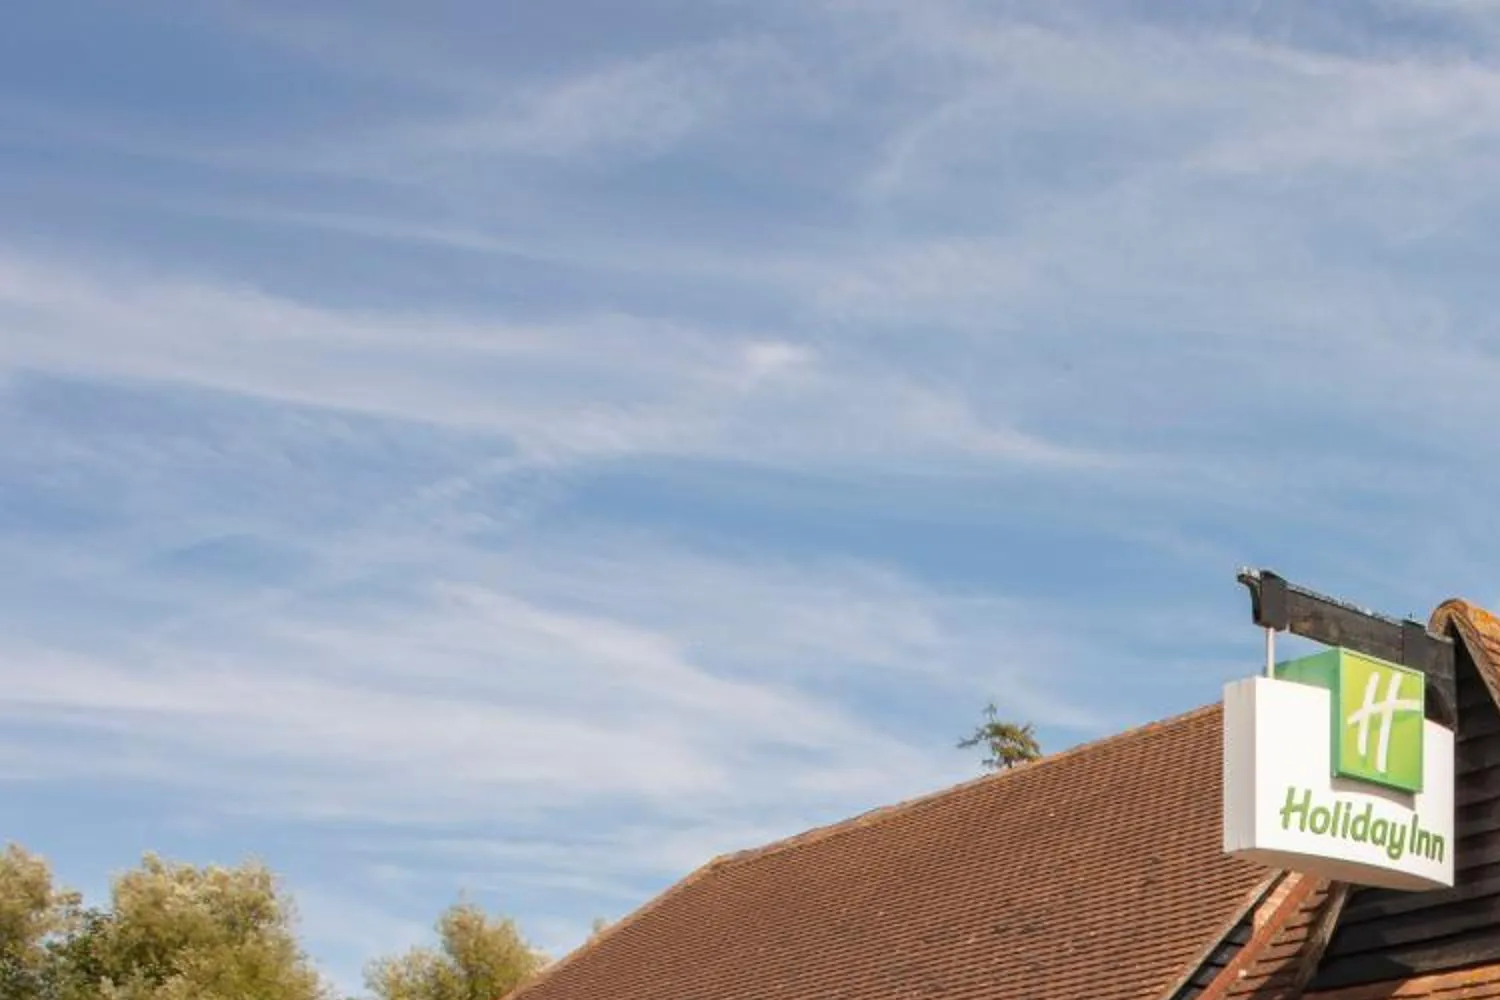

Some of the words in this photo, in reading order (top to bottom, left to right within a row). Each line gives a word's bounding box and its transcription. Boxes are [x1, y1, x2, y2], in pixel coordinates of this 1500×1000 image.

[1347, 671, 1420, 772] H
[1280, 787, 1407, 858] Holiday
[1410, 814, 1444, 863] Inn
